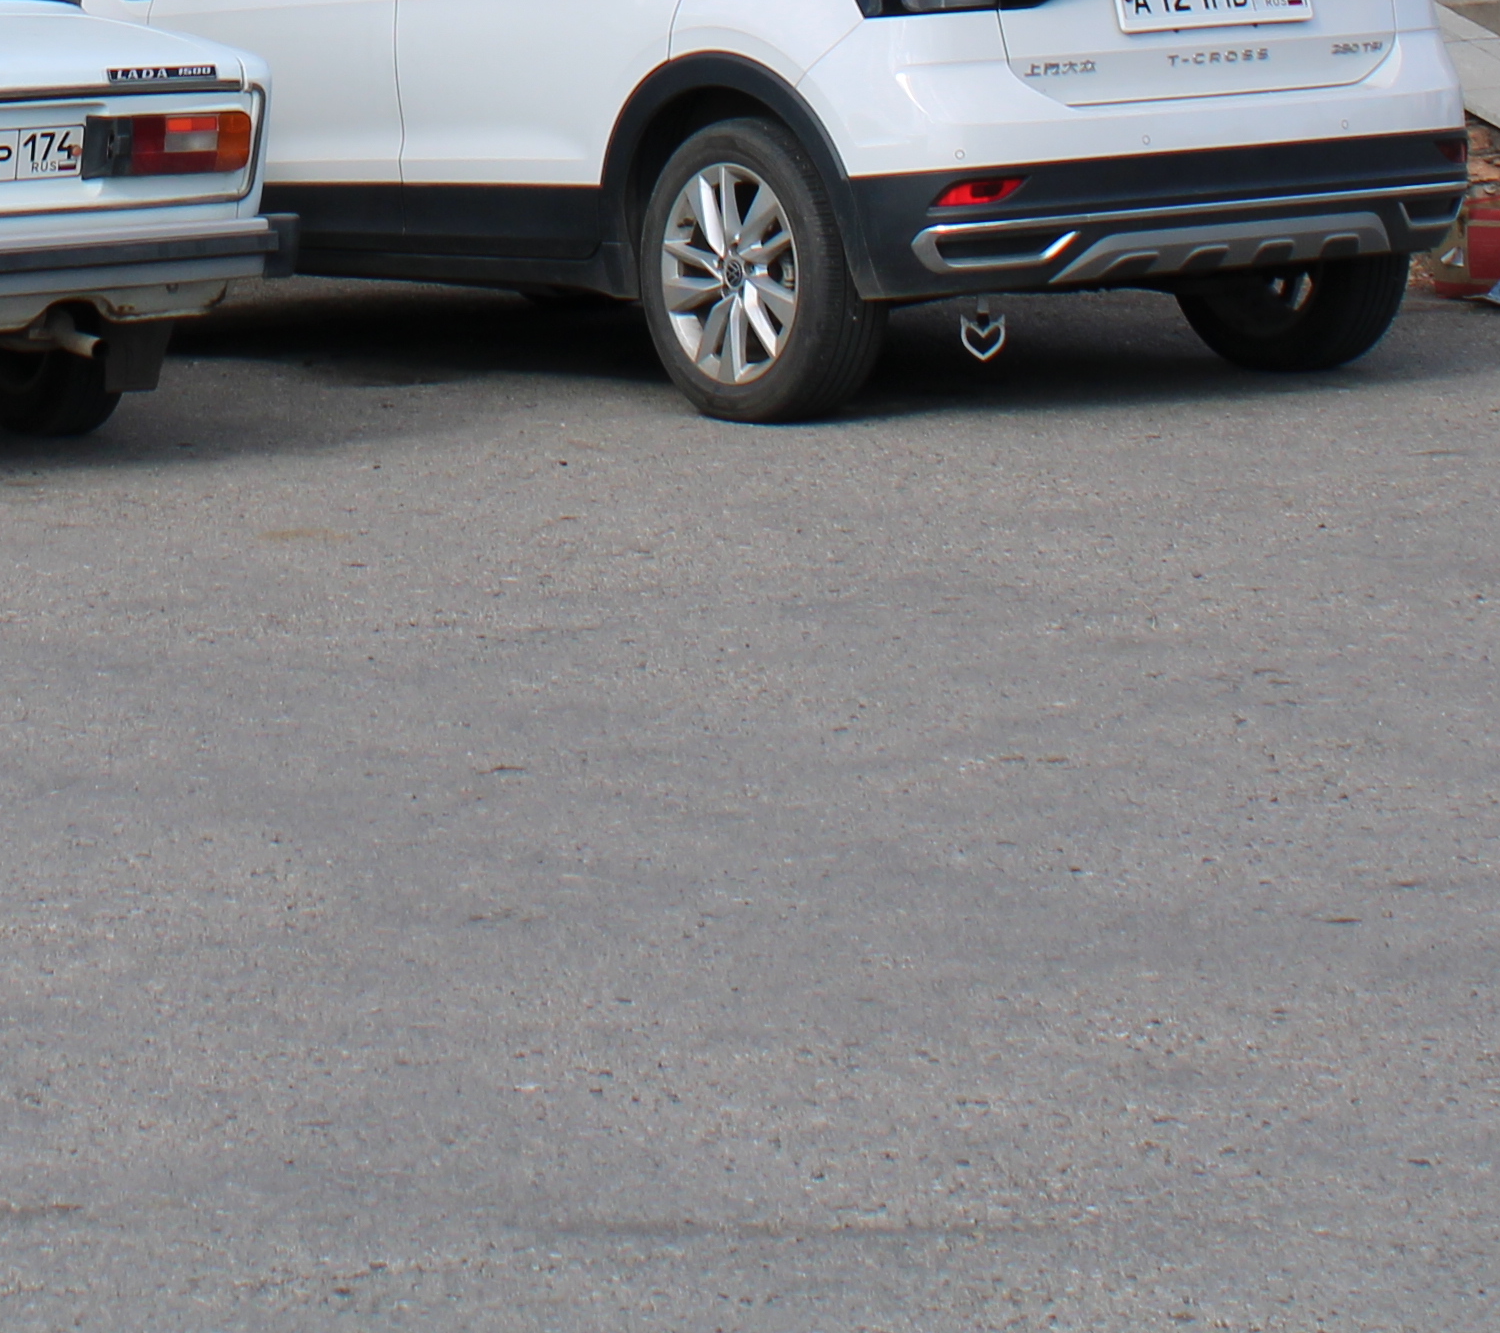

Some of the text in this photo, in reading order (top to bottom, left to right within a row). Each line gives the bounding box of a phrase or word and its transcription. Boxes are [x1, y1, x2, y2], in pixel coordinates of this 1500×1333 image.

[1167, 48, 1271, 67] T-CROSS
[116, 68, 169, 80] LADA
[22, 131, 74, 162] 174
[31, 161, 57, 173] RUS
